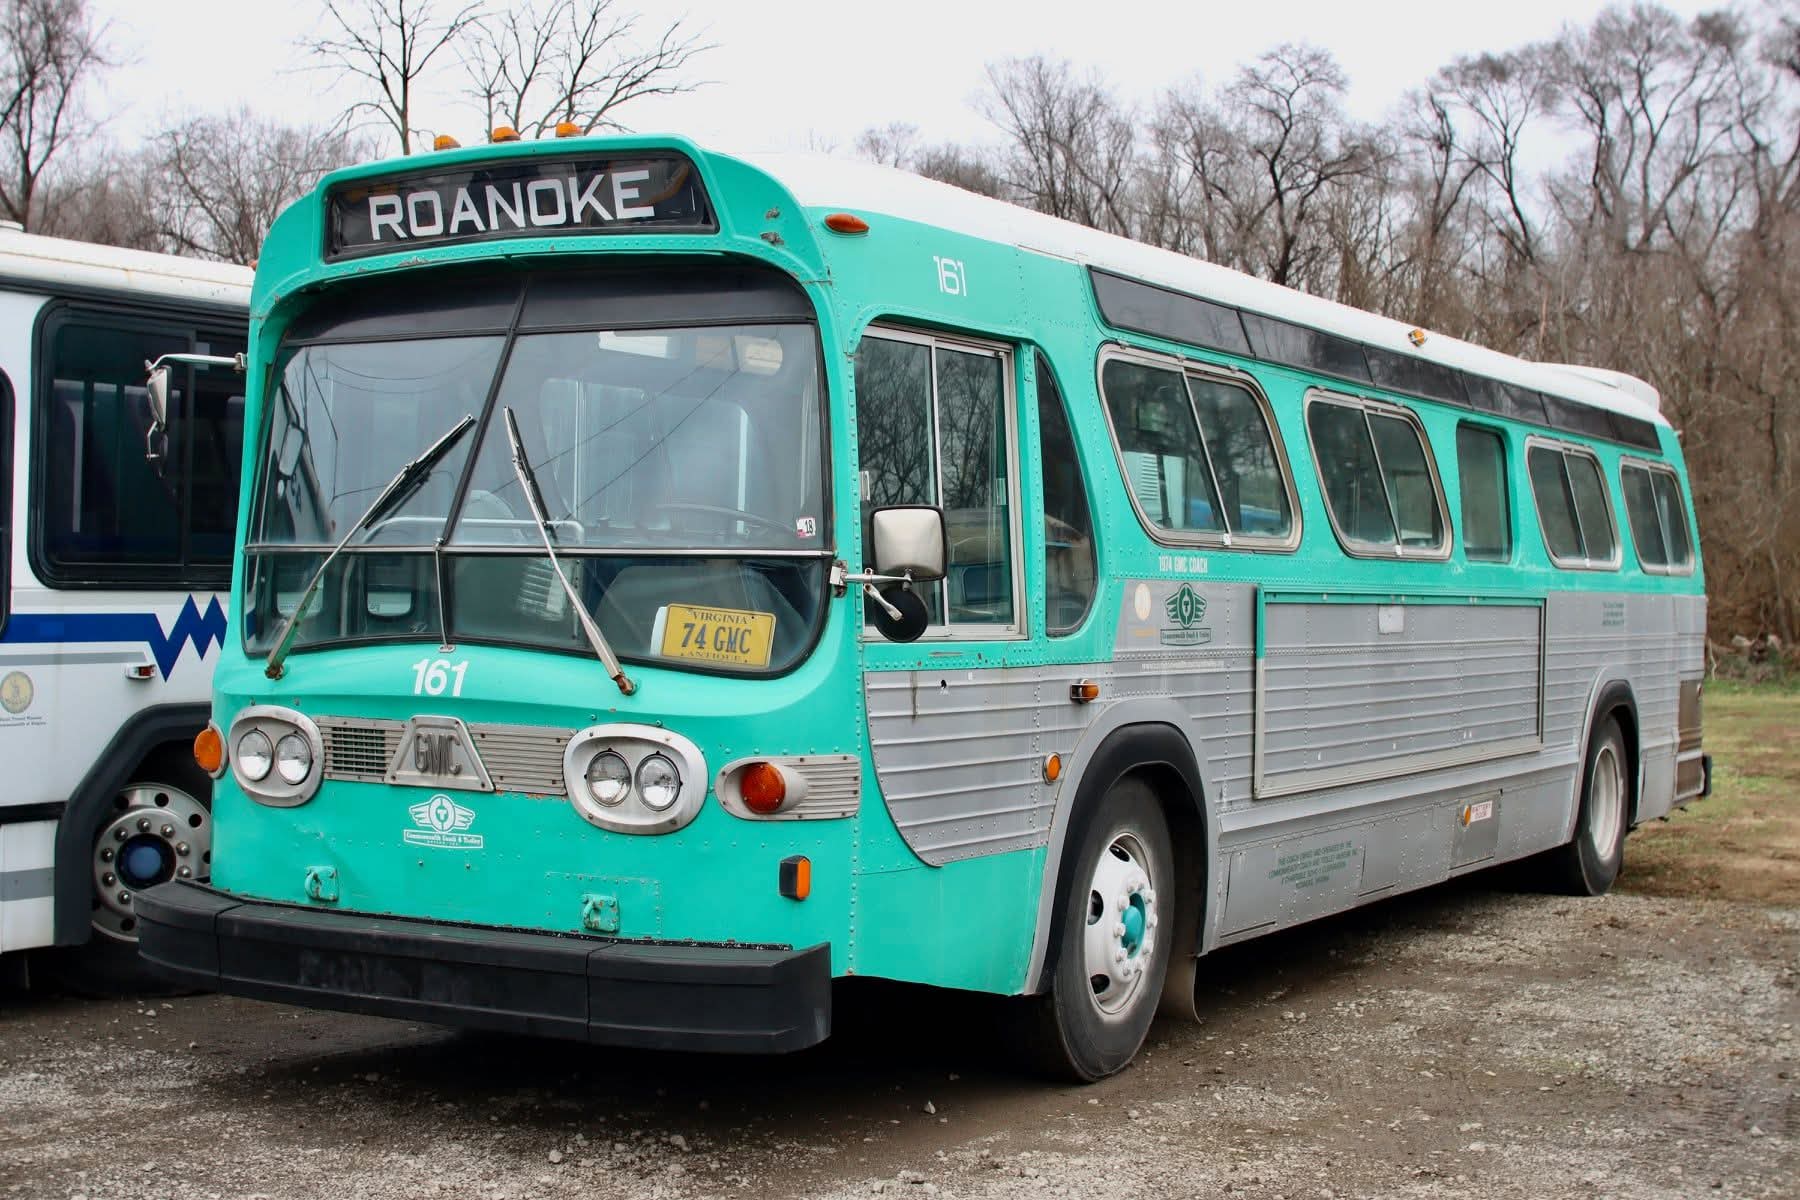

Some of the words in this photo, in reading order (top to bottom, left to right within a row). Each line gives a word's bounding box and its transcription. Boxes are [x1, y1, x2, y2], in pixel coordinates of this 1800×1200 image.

[368, 169, 655, 240] ROANOKE
[933, 256, 967, 297] 161
[804, 519, 814, 534] 18
[1174, 557, 1188, 573] GMC
[1189, 557, 1208, 574] COACH
[692, 610, 749, 625] VIRGINIA
[681, 622, 707, 649] 74
[714, 626, 752, 654] GMC
[412, 658, 469, 697] 161
[414, 732, 462, 776] GMC
